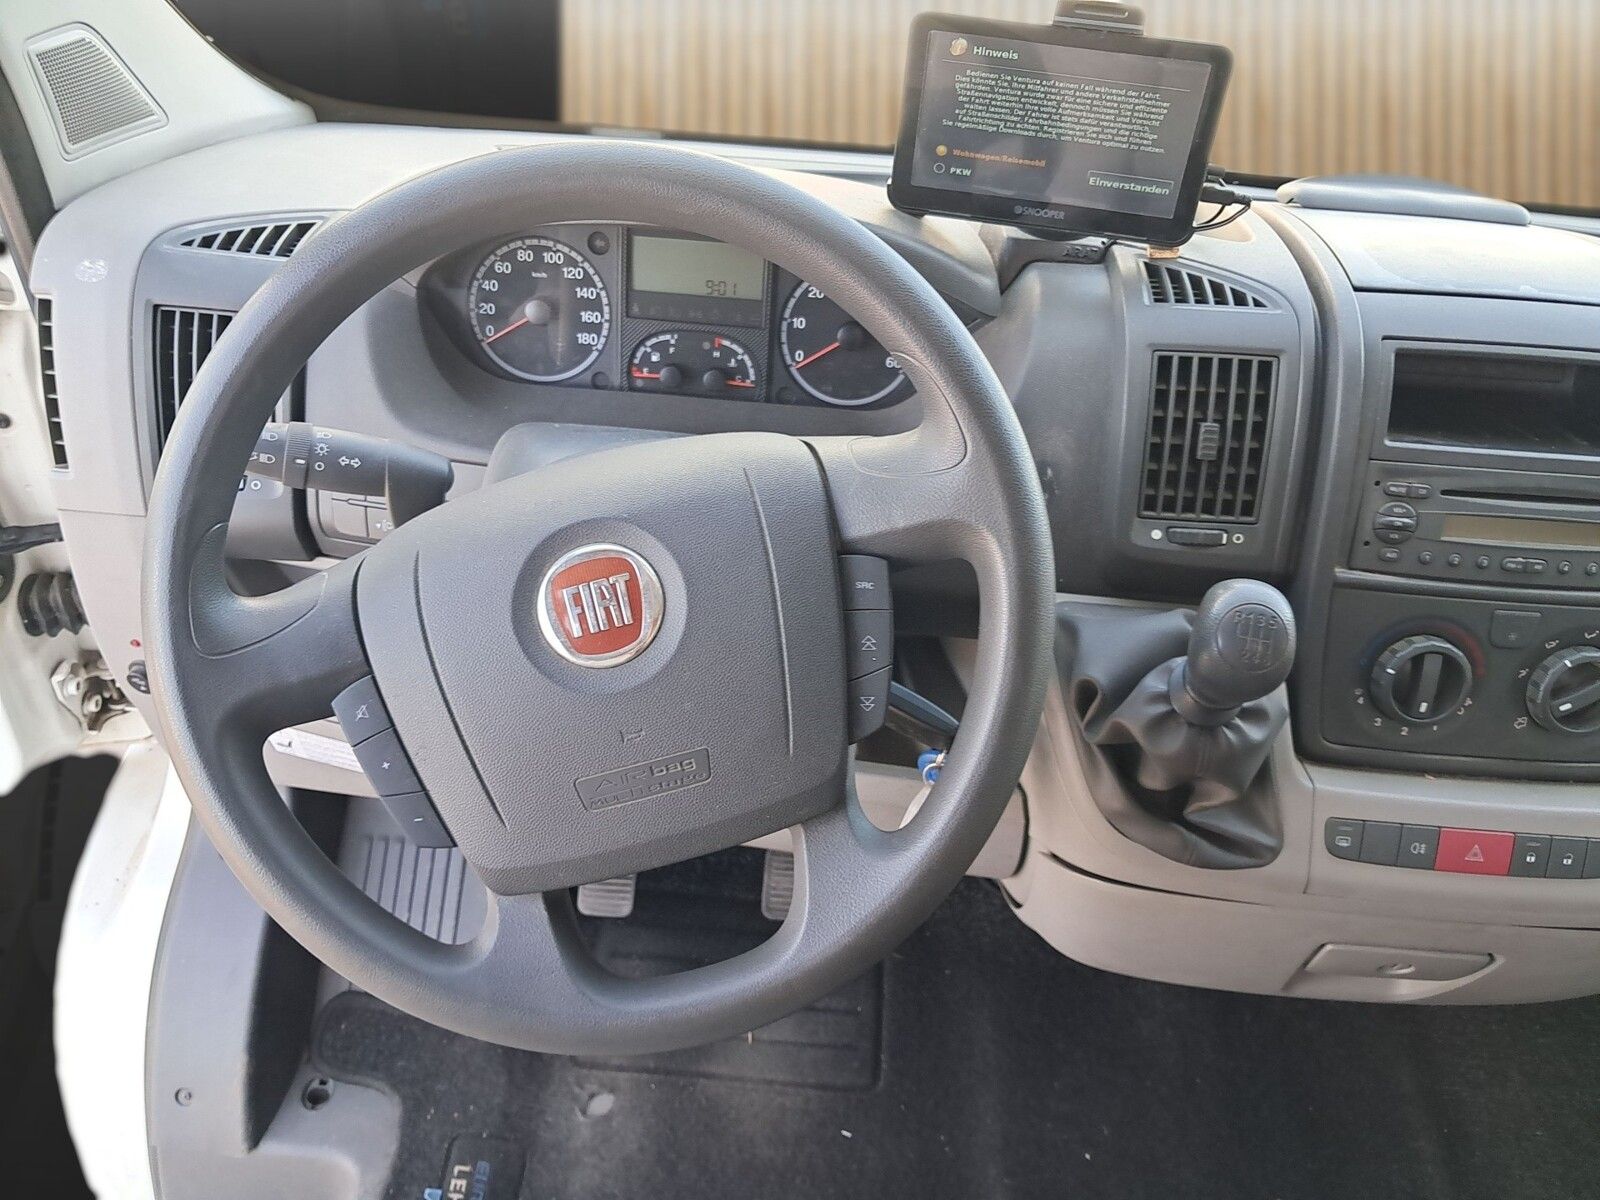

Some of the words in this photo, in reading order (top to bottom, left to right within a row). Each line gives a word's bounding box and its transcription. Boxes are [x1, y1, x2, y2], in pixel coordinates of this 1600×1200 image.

[974, 46, 1018, 60] Hinweis
[955, 74, 970, 82] Dies
[966, 70, 998, 79] Bedienen
[1013, 76, 1040, 84] Ventura
[1056, 81, 1078, 89] keinen
[994, 87, 1021, 96] Ventura
[950, 167, 972, 176] PKW
[1088, 177, 1170, 195] Einverstanden
[1022, 206, 1065, 220] SNOOPER
[517, 250, 534, 262] 80
[542, 252, 564, 264] 100
[494, 262, 512, 274] 60
[562, 267, 584, 279] 120
[482, 280, 498, 292] 40
[575, 287, 596, 300] 140
[480, 303, 496, 315] 20
[580, 312, 602, 323] 160
[792, 318, 806, 329] 10
[486, 326, 494, 336] 0
[576, 333, 598, 345] 180
[794, 350, 804, 362] 0
[856, 582, 875, 590] SRC
[561, 572, 634, 638] FIAT
[1400, 726, 1408, 736] 2
